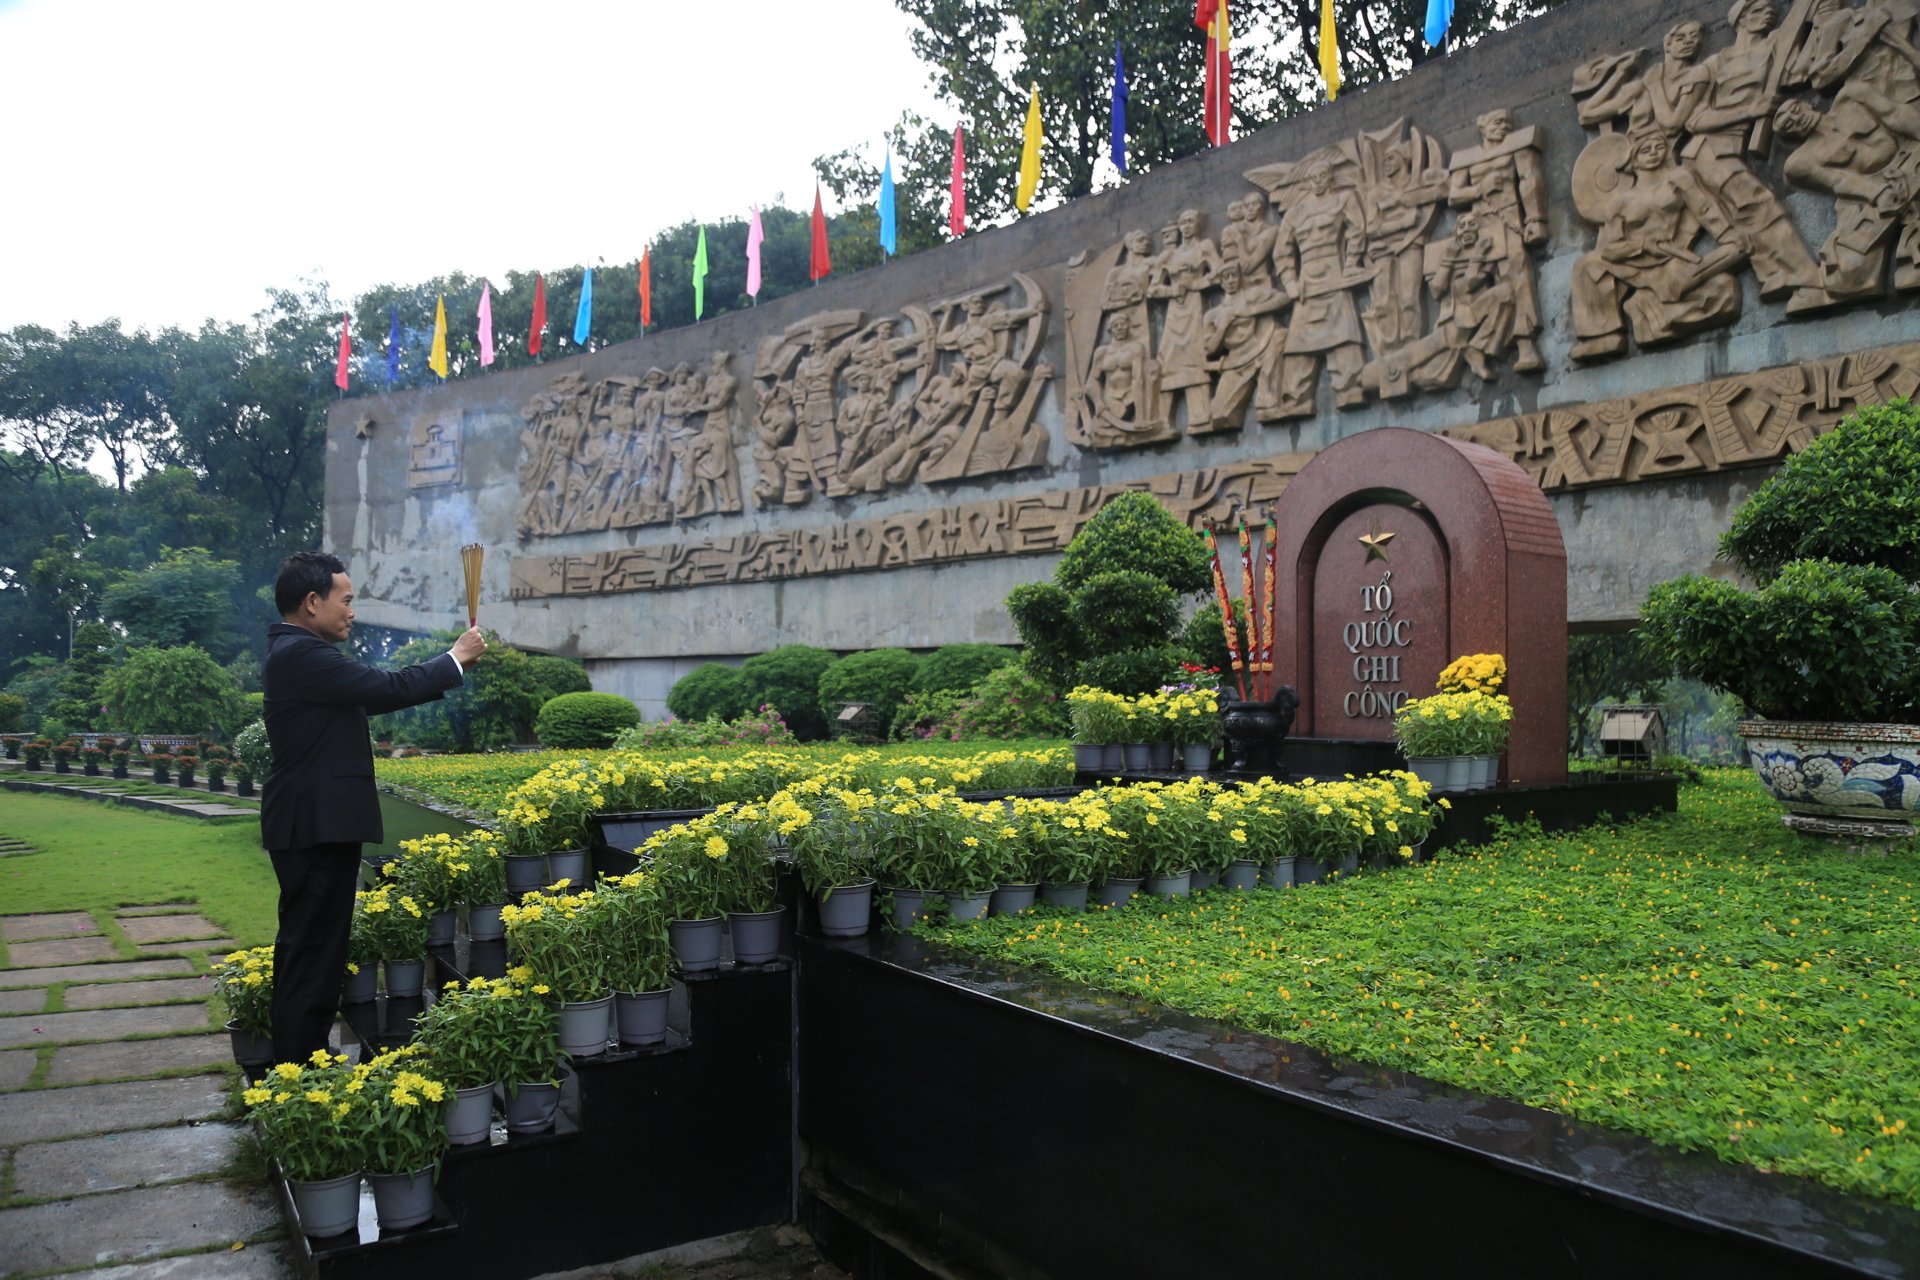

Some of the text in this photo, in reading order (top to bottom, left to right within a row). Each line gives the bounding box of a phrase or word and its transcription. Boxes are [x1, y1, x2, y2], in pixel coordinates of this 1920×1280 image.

[1360, 570, 1392, 611] TỔ
[1343, 611, 1410, 653] QUỐC
[1353, 655, 1400, 682] GHI
